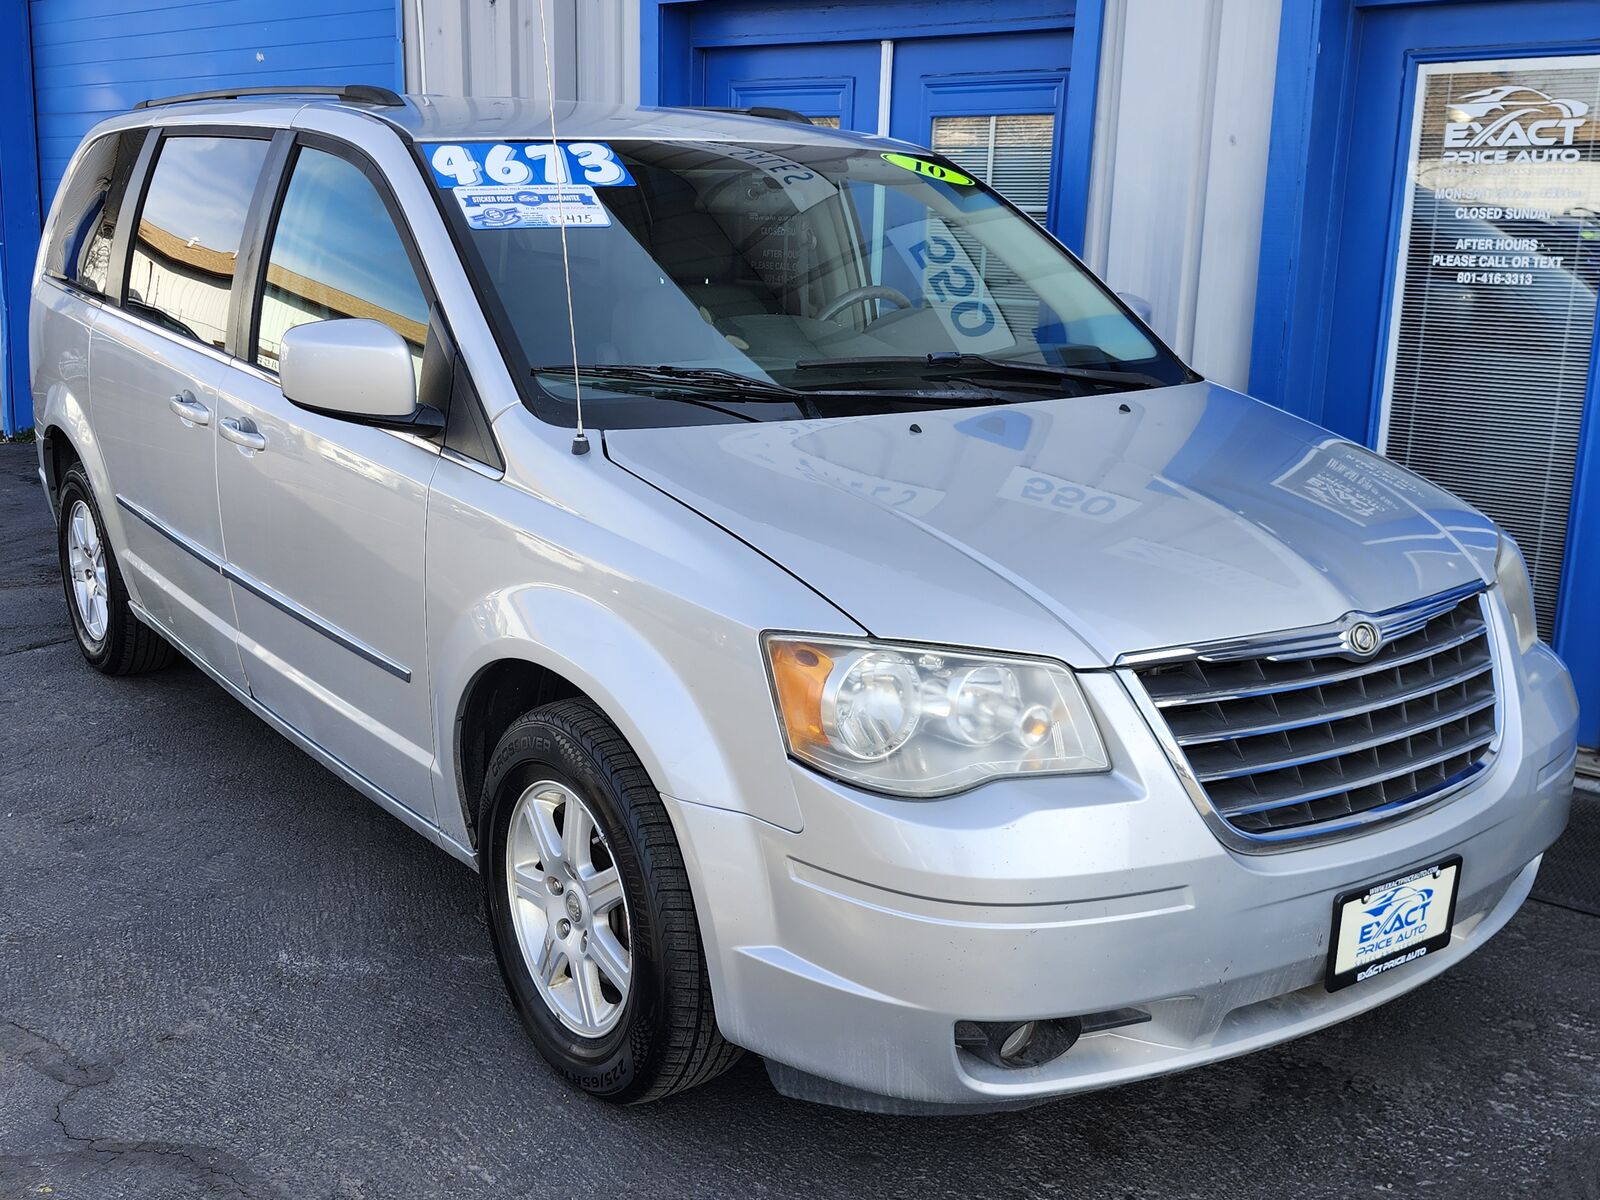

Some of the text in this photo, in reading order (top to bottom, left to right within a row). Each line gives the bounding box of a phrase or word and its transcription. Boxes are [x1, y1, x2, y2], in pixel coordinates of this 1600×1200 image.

[1444, 118, 1586, 148] EXACT
[432, 143, 626, 186] 4673
[1441, 149, 1581, 165] PRICE AUTO
[1455, 207, 1503, 219] CLOSED
[1455, 238, 1539, 251] AFTER HOURS
[1432, 255, 1564, 269] PLEASE CALL OR TEXT
[1456, 272, 1533, 286] 801-416-3313
[1358, 901, 1432, 944] EXACT
[1356, 938, 1392, 958] PRICE
[1396, 923, 1427, 943] AUTO
[1357, 963, 1382, 982] EXACT
[1382, 954, 1406, 971] PRICE
[1405, 947, 1427, 962] AUTO
